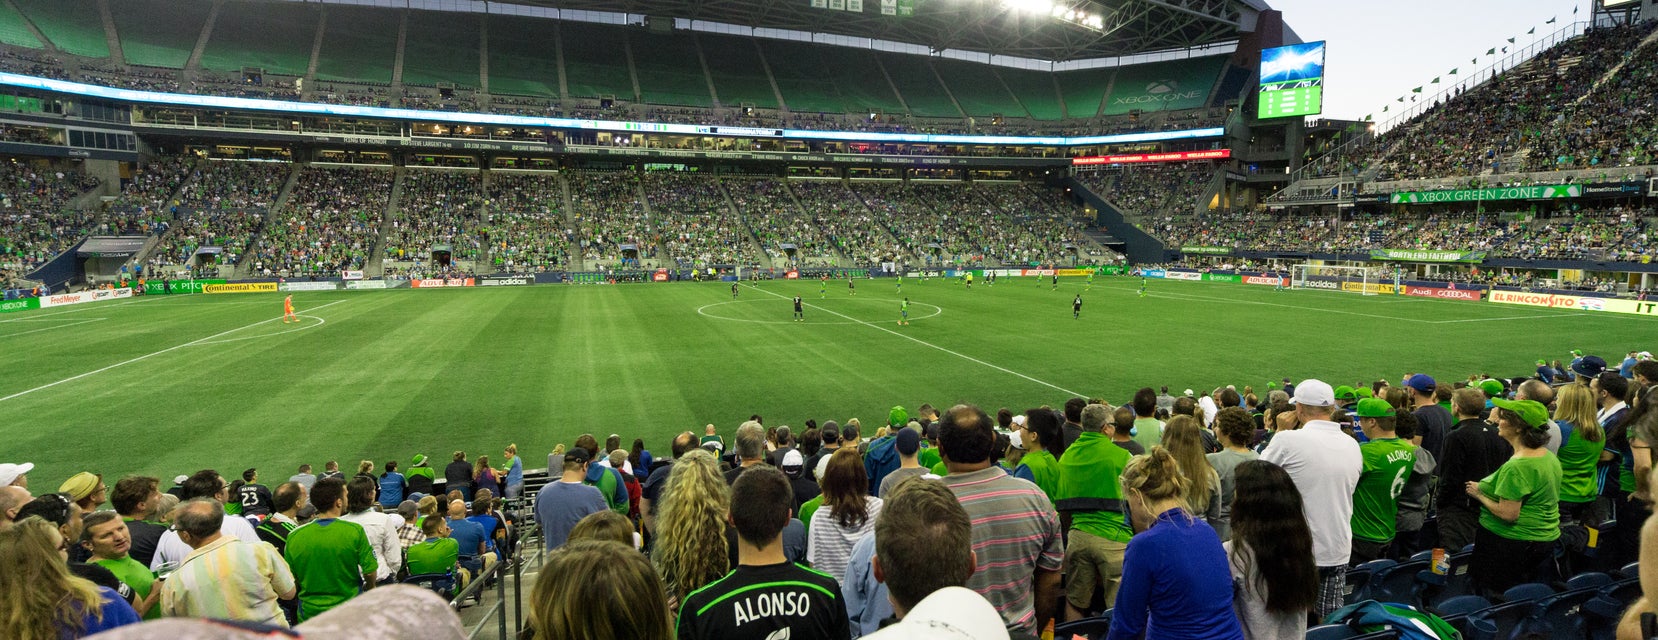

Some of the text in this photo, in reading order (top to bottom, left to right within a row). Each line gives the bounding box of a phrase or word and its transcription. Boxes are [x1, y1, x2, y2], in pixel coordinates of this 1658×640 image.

[1114, 90, 1201, 104] XBOX ONE
[1421, 187, 1539, 203] XBOX GREEN ZONE
[151, 283, 178, 291] XBX
[205, 282, 249, 292] Continental
[1310, 280, 1337, 288] adidas
[1412, 288, 1432, 296] Audi
[1494, 293, 1575, 308] EL RINCONSITO
[1386, 449, 1412, 464] ALONSO
[1390, 465, 1406, 500] 6
[241, 492, 259, 507] 23
[734, 591, 810, 627] ALONSO
